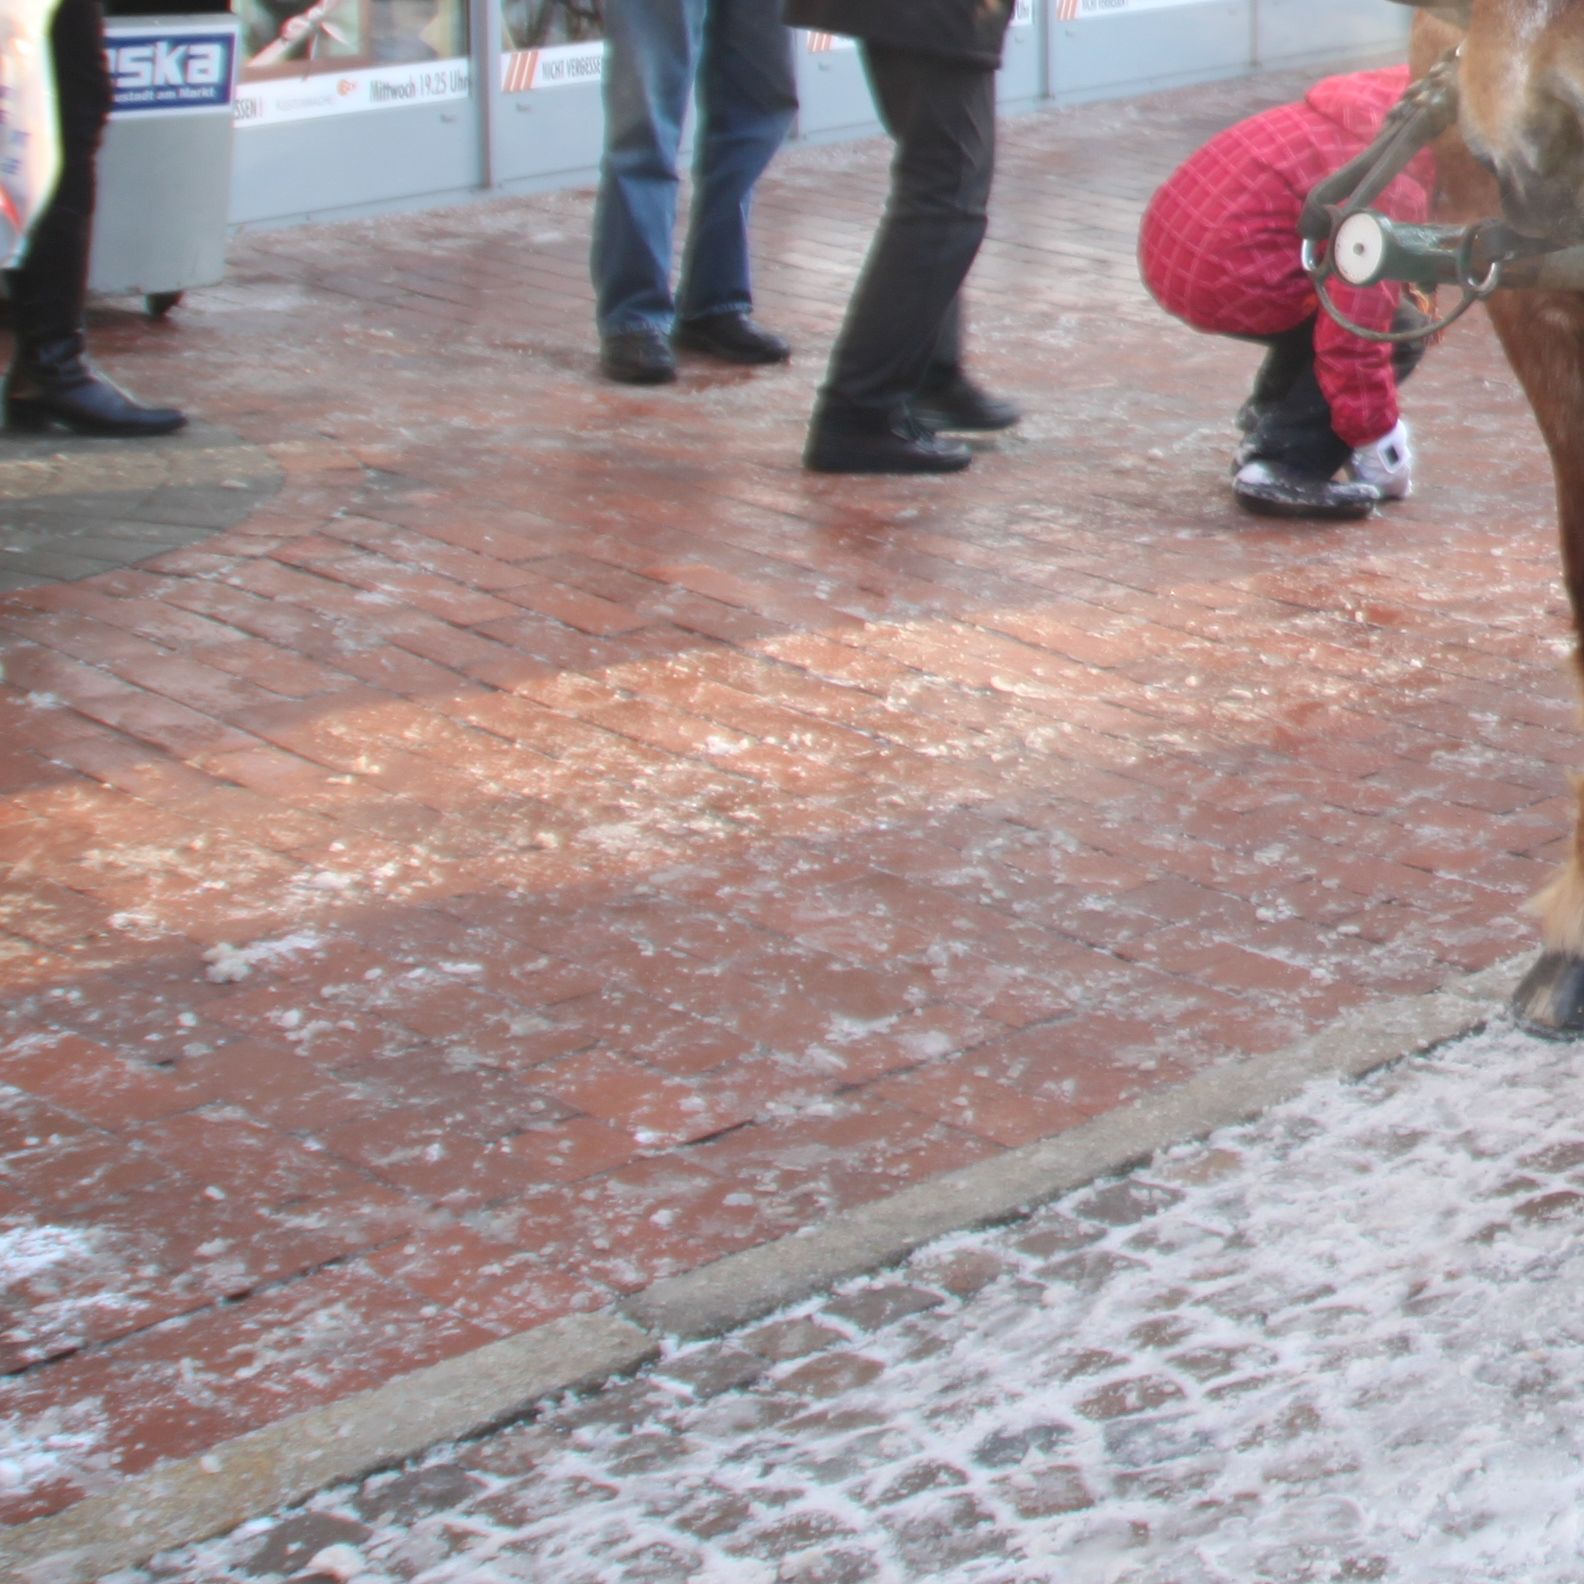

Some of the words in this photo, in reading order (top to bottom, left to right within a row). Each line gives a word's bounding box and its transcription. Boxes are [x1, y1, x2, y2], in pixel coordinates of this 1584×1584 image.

[542, 59, 566, 81] NICHT
[567, 56, 601, 78] VERGESSE
[370, 75, 416, 103] Mittwoch
[420, 72, 447, 97] 19.25
[449, 68, 472, 92] Uhr
